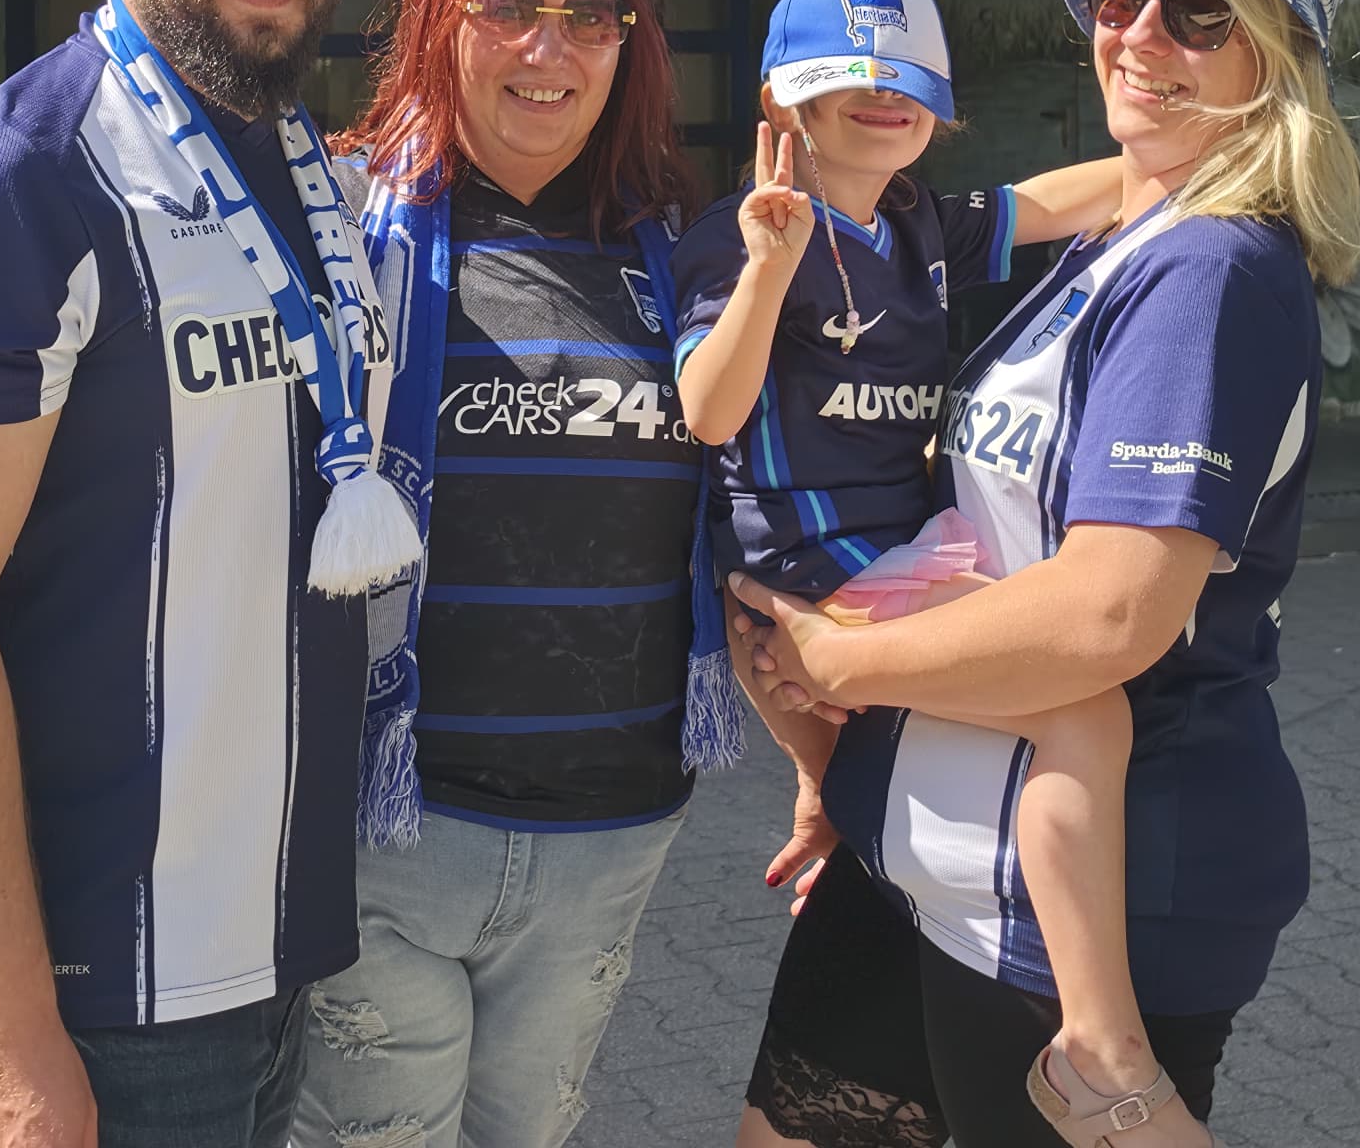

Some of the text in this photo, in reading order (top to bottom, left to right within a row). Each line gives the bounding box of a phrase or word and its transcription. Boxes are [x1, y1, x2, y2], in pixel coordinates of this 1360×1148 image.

[170, 222, 224, 240] CASTORE
[471, 376, 578, 407] check
[1110, 441, 1232, 472] Sparda-Bank
[1151, 461, 1196, 474] Berlin
[51, 964, 91, 975] ERTEK
